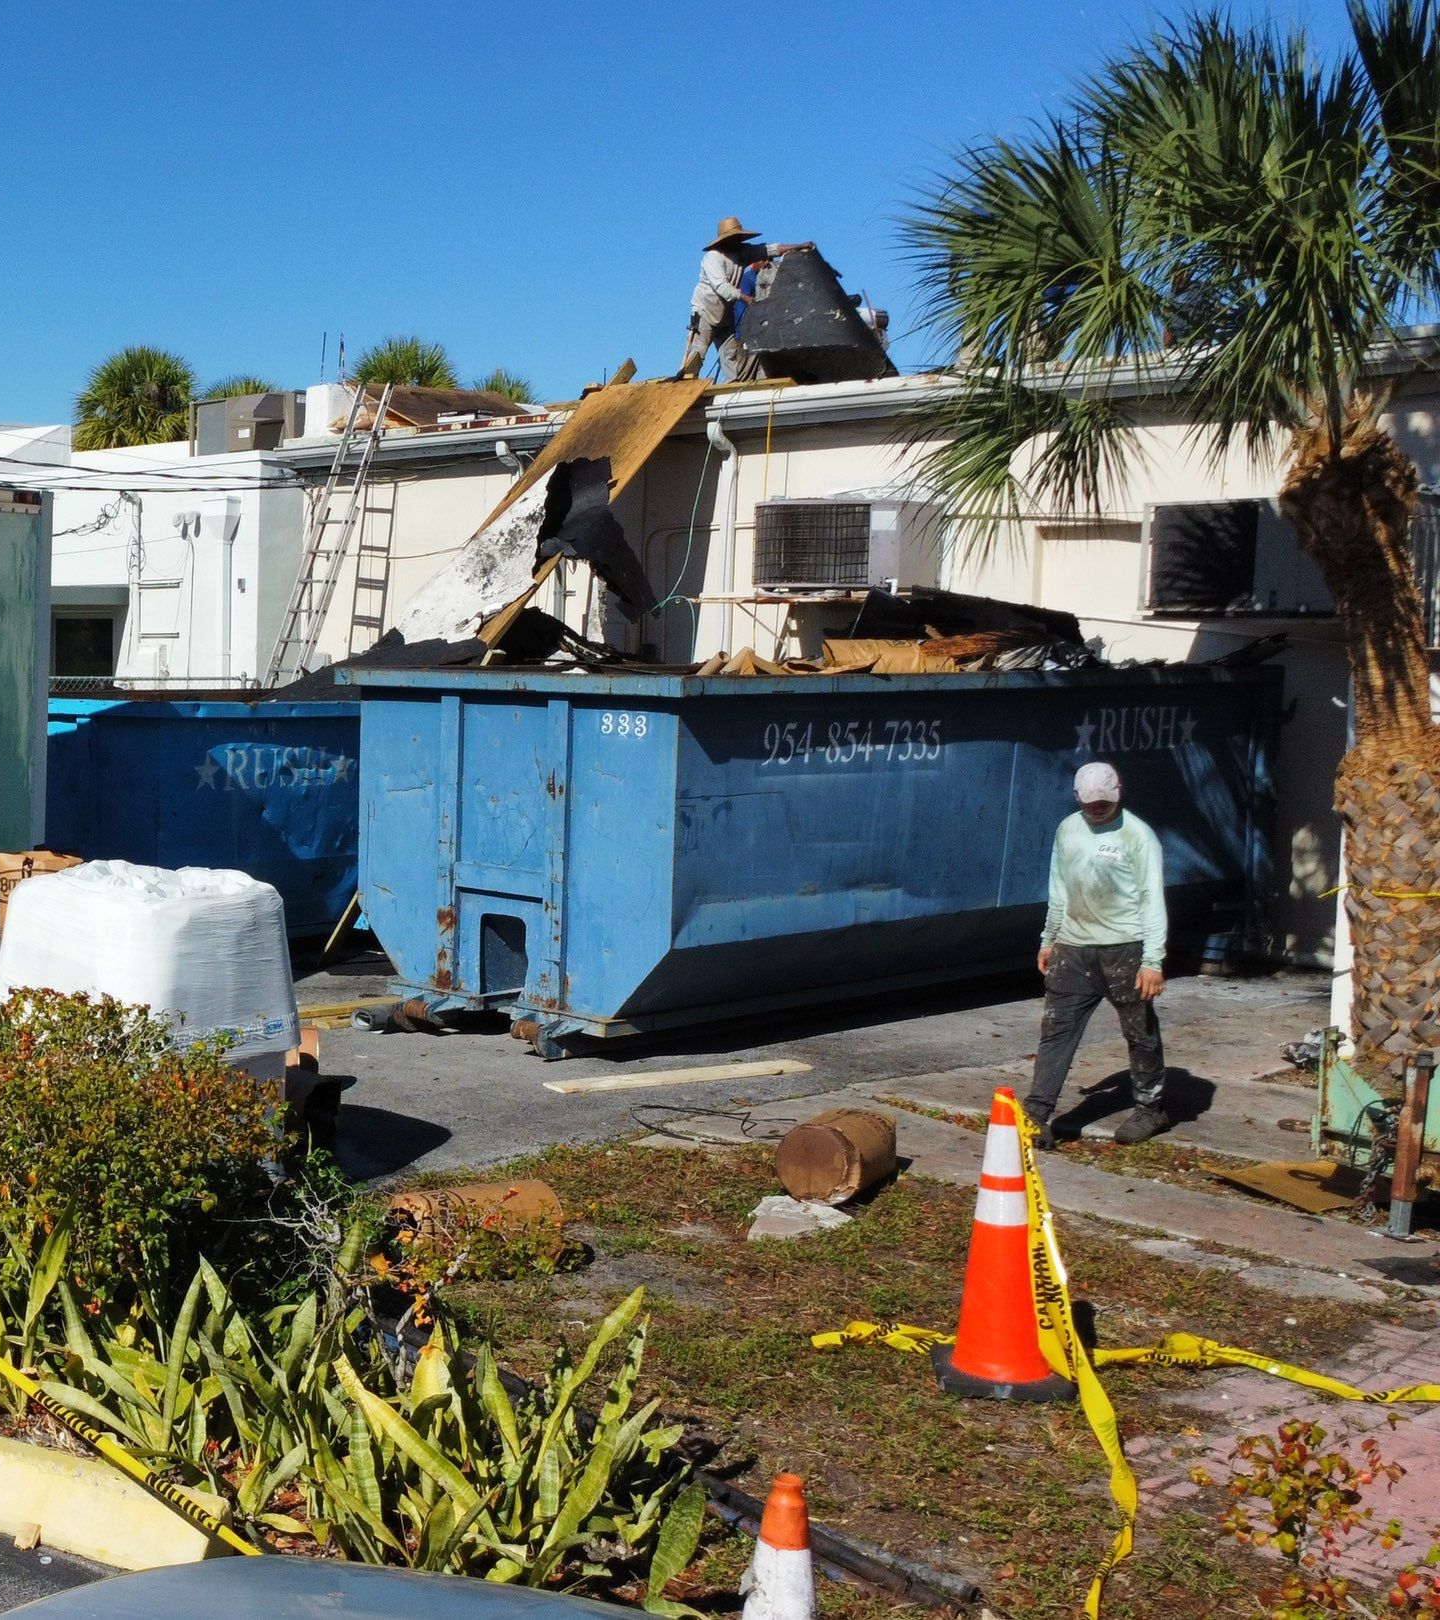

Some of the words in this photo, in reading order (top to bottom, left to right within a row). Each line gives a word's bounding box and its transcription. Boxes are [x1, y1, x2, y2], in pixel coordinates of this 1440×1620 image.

[601, 712, 648, 738] 333
[762, 720, 942, 767] 954-854-7335
[1096, 706, 1180, 752] RUSH
[223, 745, 336, 792] RUSH
[0, 877, 22, 893] BIT
